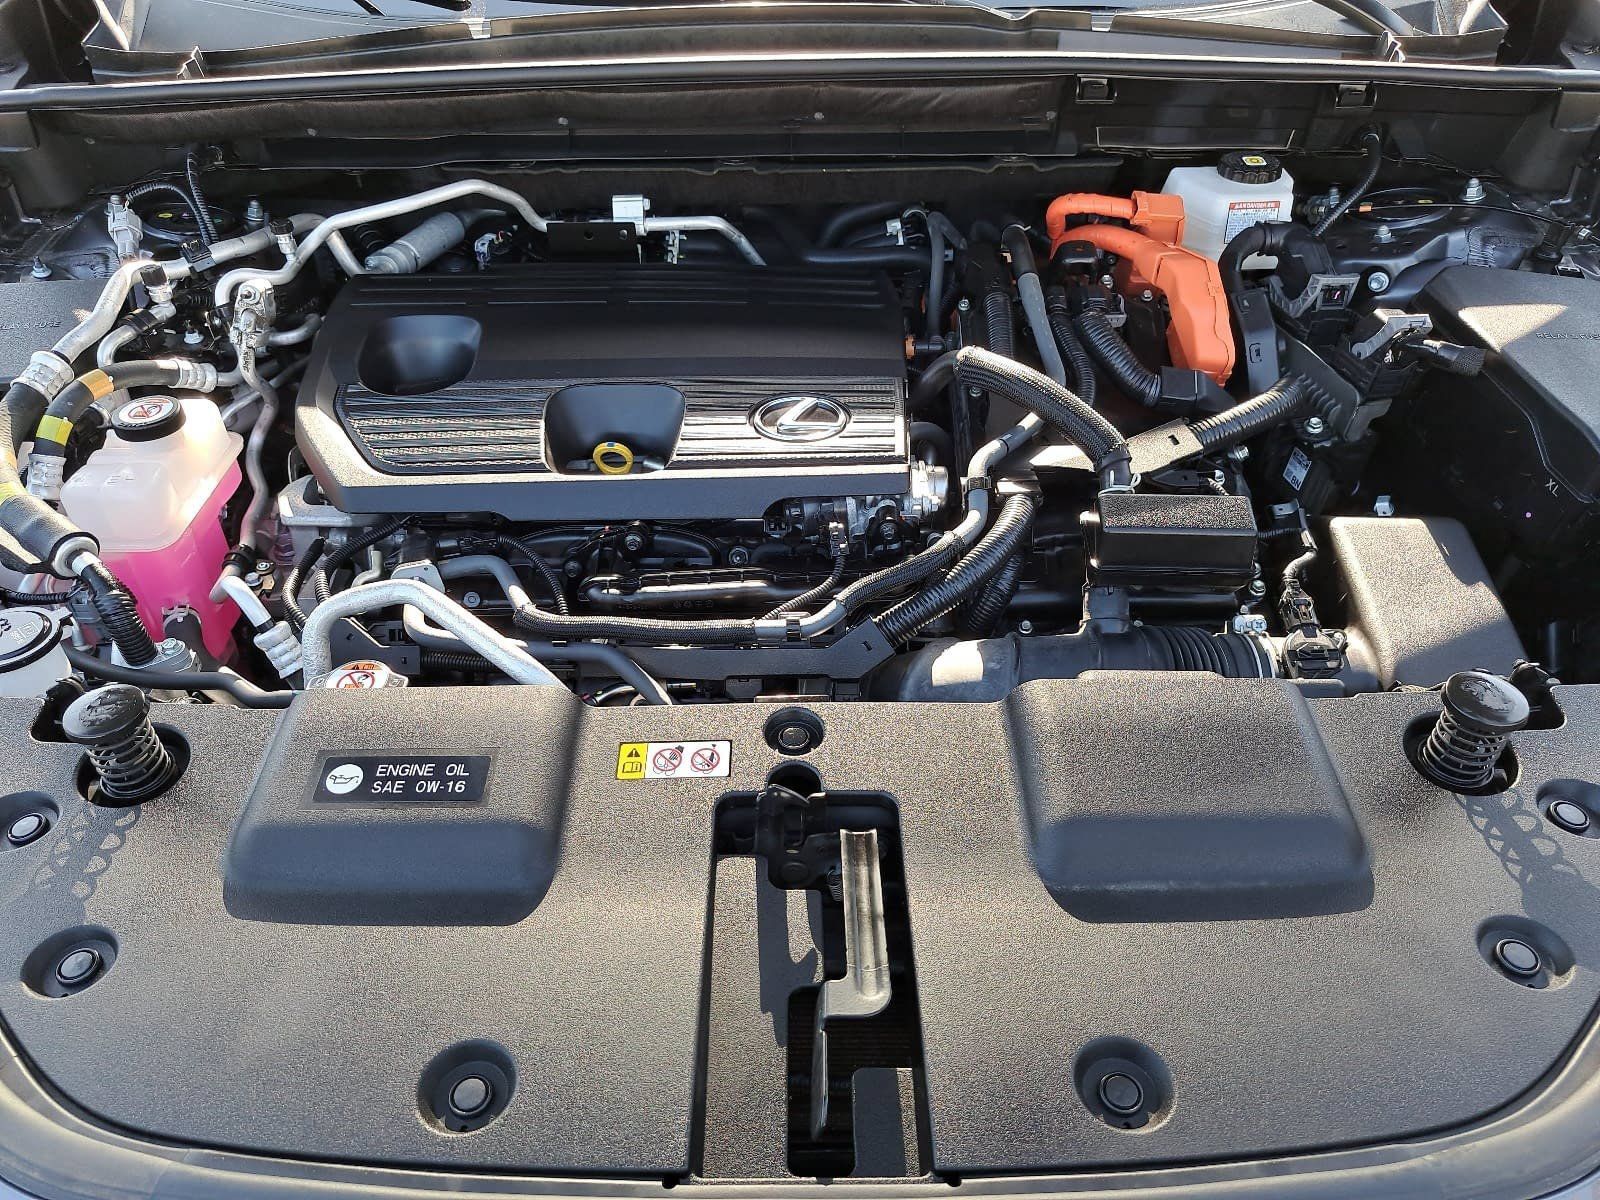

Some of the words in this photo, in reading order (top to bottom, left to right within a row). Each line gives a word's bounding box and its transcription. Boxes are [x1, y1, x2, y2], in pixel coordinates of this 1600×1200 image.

[376, 763, 435, 777] ENGINE
[445, 763, 470, 776] OIL
[371, 780, 405, 793] SAE
[415, 780, 465, 793] 0W-16
